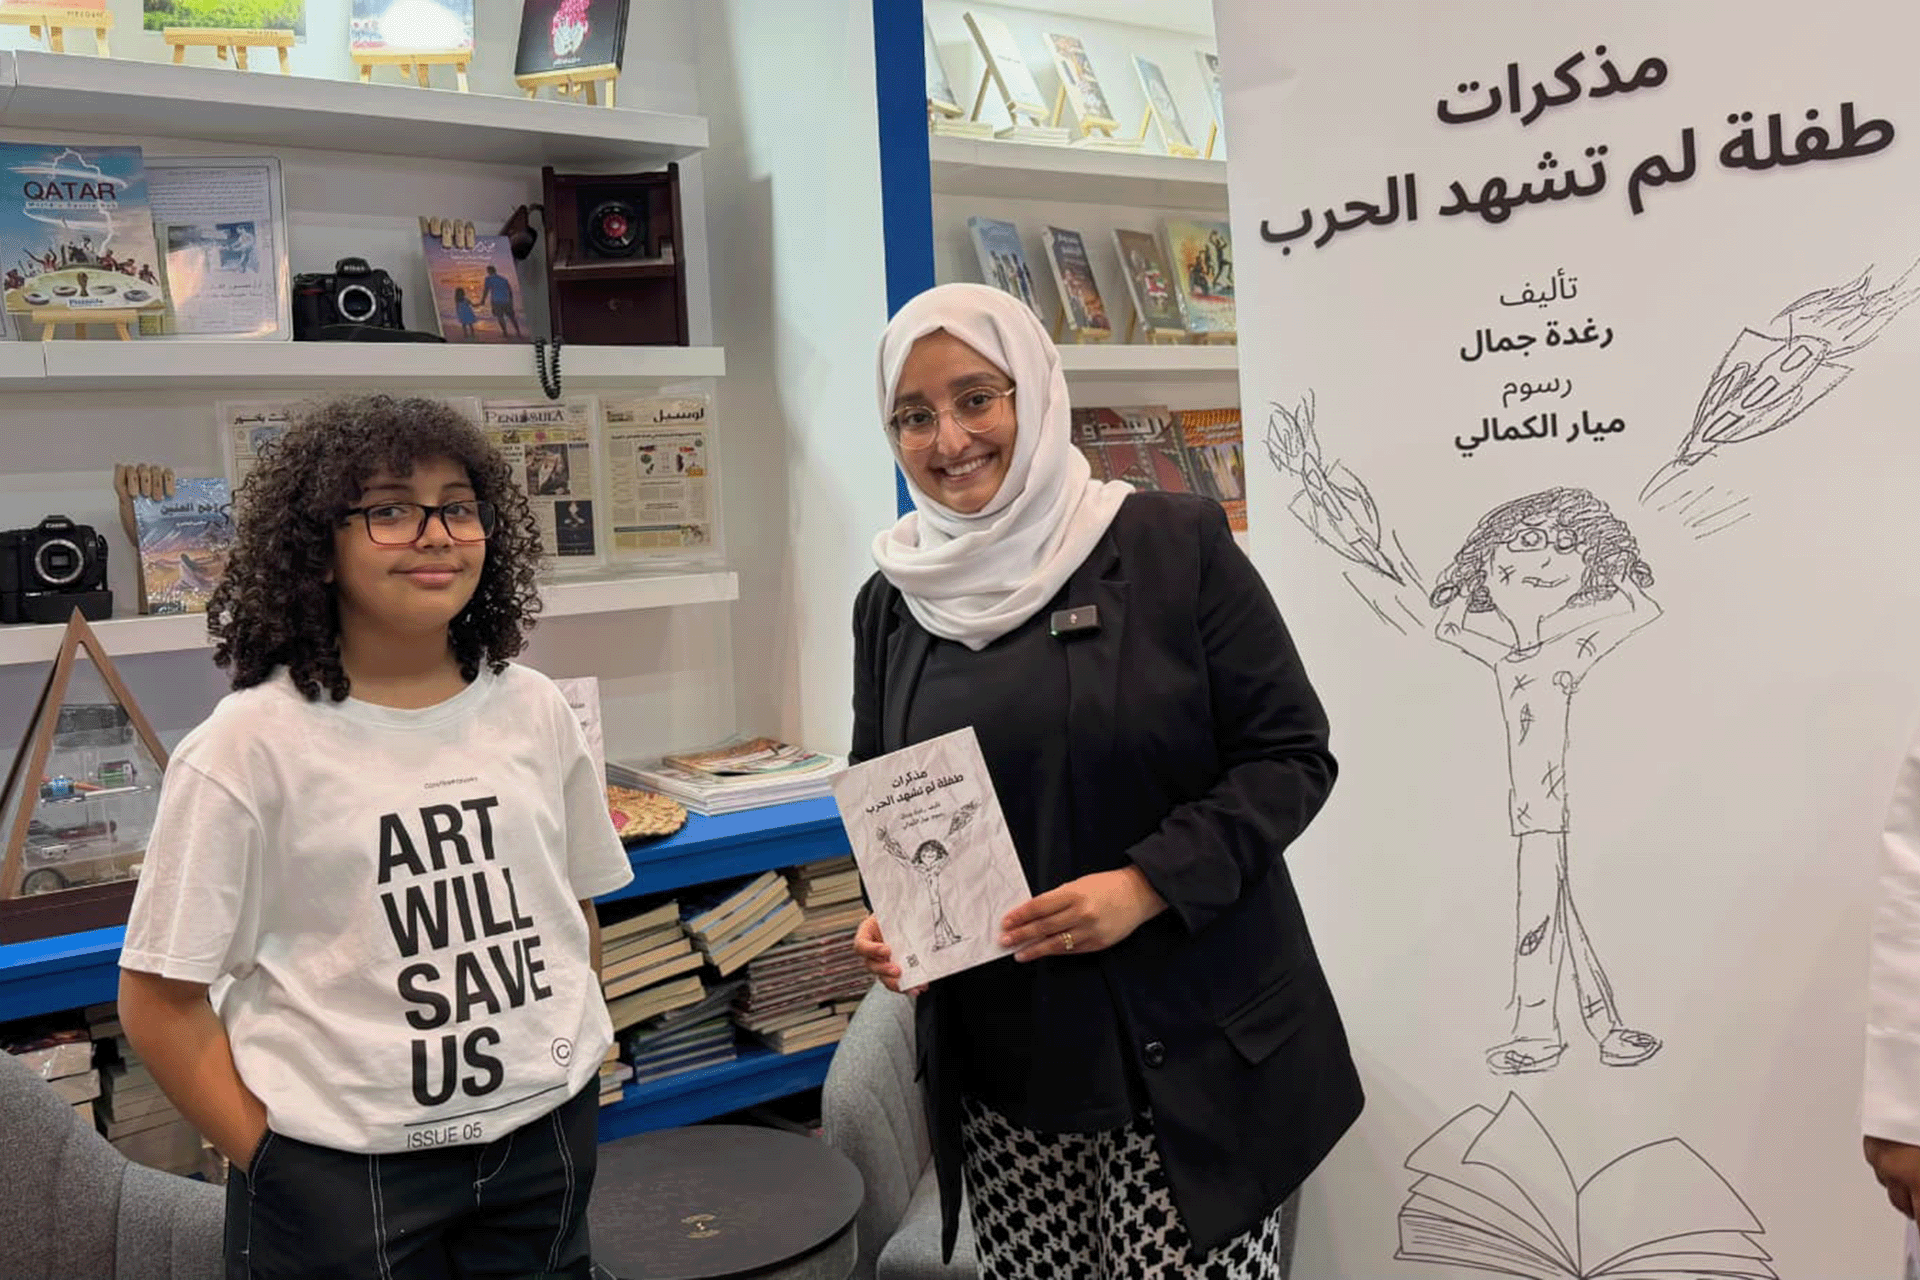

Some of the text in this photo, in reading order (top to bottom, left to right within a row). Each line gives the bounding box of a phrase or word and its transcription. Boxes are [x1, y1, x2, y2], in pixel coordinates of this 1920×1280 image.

[1437, 45, 1667, 127] مذكرات
[23, 181, 116, 200] QATAR
[1260, 101, 1895, 256] طفلة لم تشهد الحرب
[1500, 267, 1578, 309] تأليف
[1461, 317, 1614, 362] رغدة جمال
[1502, 377, 1573, 409] رسوم
[485, 410, 564, 423] PENISULA
[653, 407, 704, 423] لوسيل
[1454, 410, 1626, 458] ميار الكمالي
[865, 774, 964, 815] طفلة لم تشهد الحرب
[892, 769, 928, 789] مذكرات
[377, 796, 499, 885] ART
[380, 867, 534, 958] WILL
[397, 935, 553, 1031] SAVE
[411, 1026, 504, 1107] US
[407, 1122, 483, 1149] ISSUE 05
